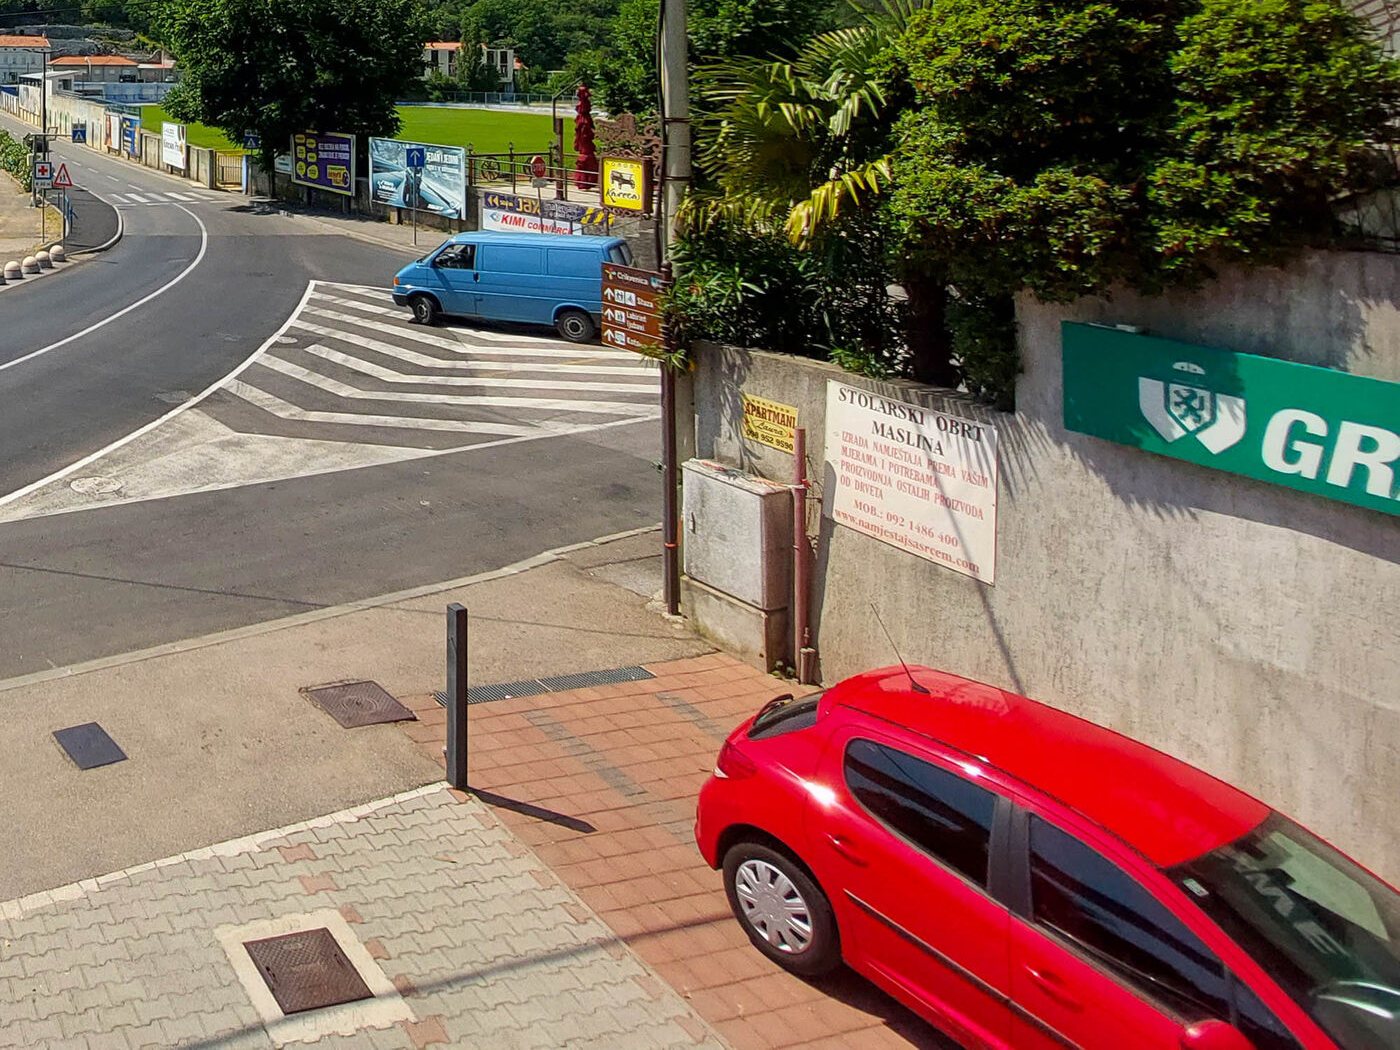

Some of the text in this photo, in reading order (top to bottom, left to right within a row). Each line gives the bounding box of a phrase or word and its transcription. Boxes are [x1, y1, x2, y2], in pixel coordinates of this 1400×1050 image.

[501, 214, 526, 228] KIMI
[745, 402, 796, 429] APARTMANI
[838, 387, 985, 443] STOLARSKI OBRT
[760, 434, 774, 444] 952
[841, 431, 869, 449] IZRADA
[927, 459, 956, 479] PREMA
[961, 469, 989, 489] VAŠIM
[871, 420, 945, 457] MASLINA
[1261, 408, 1400, 501] GR
[840, 475, 884, 500] OD DRVETA
[841, 445, 878, 469] MJERAMA
[888, 461, 939, 488] POTREBAMA
[840, 460, 984, 520] PROIZVODNJA OSTALIH PROIZVODA
[834, 509, 980, 574] www.namjestajsasrcem.com
[853, 500, 959, 548] MOB.: 092 1486 400
